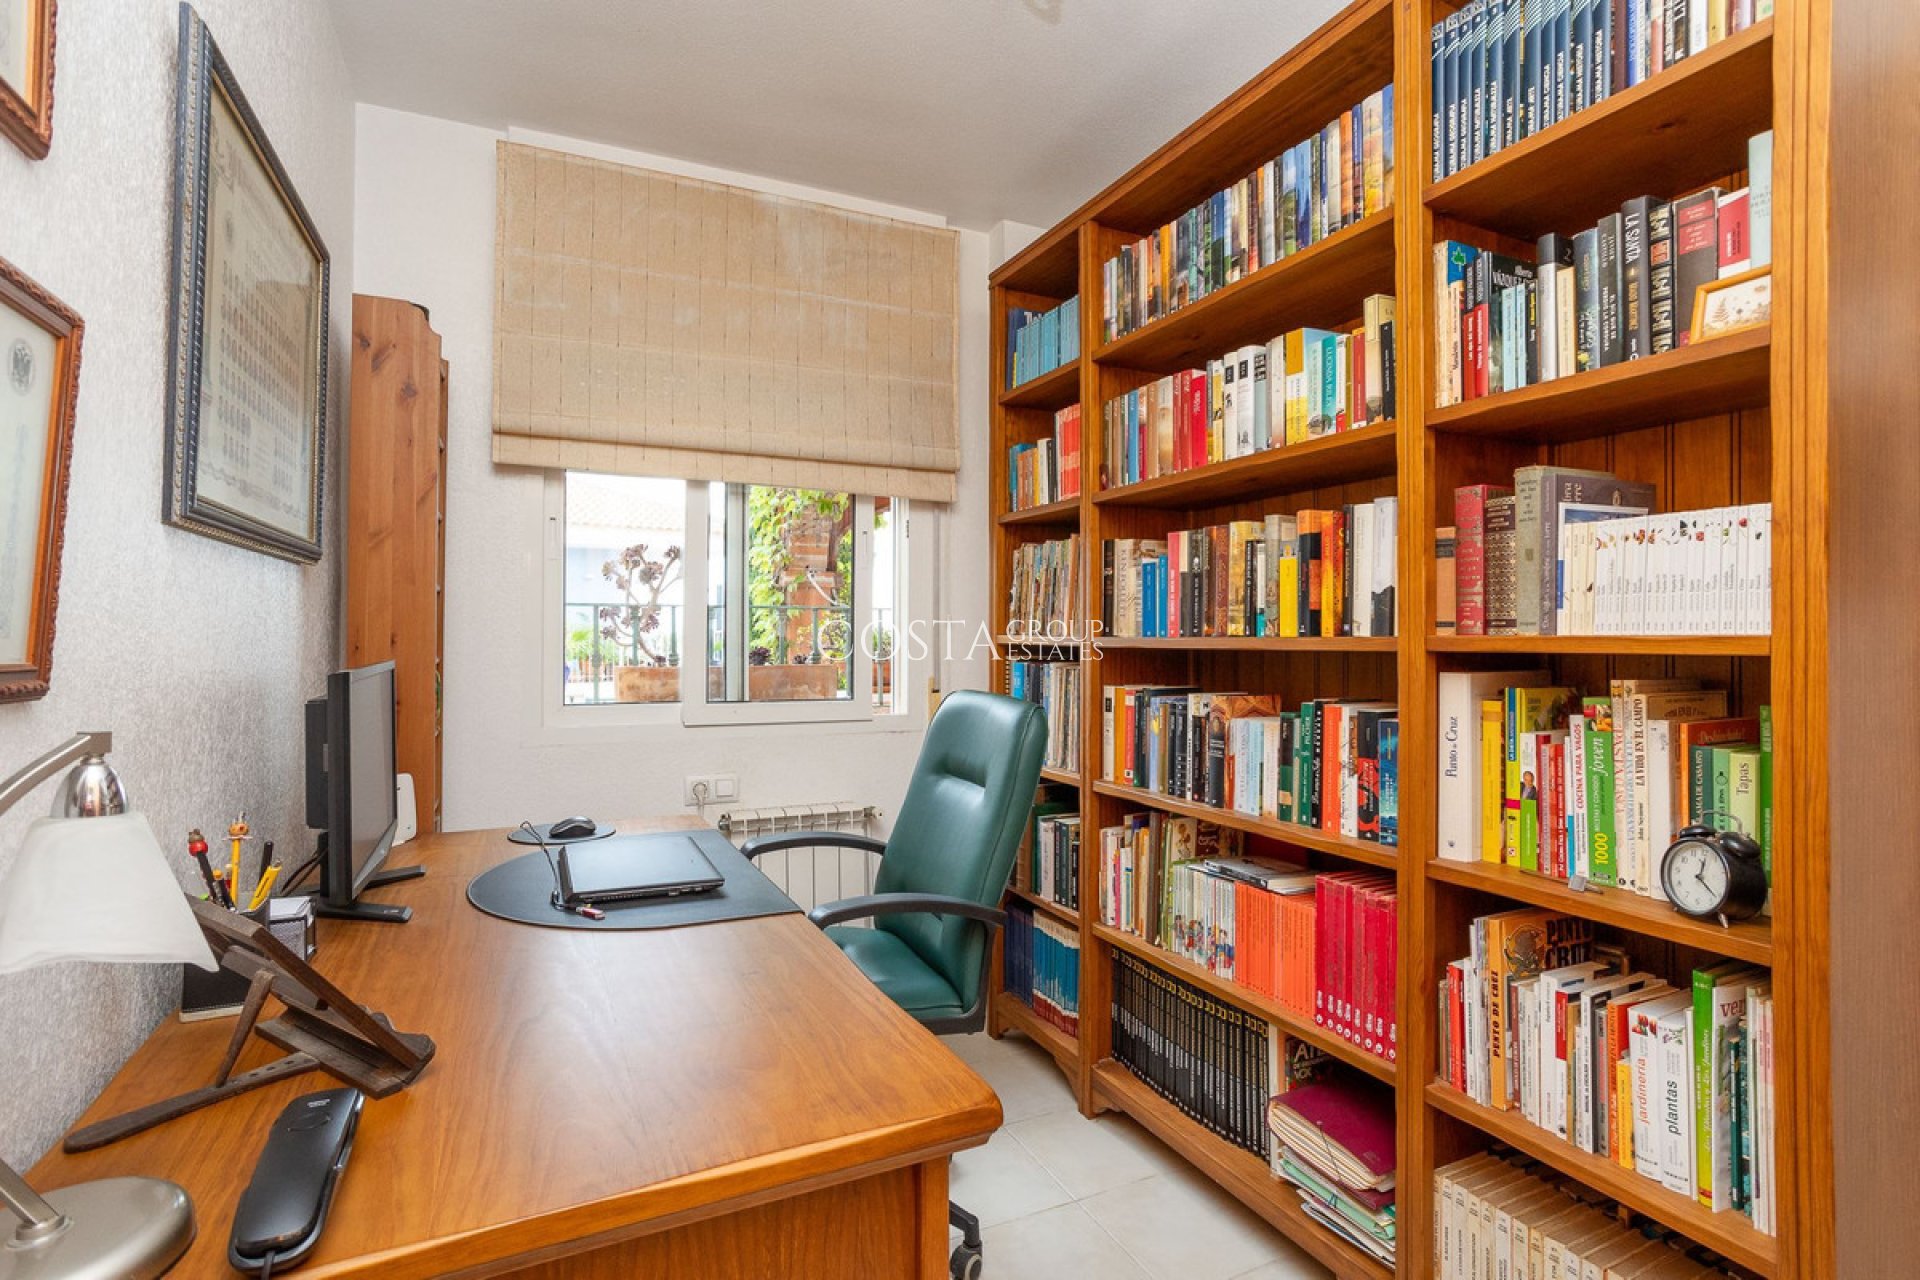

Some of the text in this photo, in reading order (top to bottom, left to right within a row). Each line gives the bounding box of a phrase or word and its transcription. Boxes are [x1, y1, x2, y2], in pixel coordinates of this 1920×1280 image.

[1626, 212, 1641, 264] LA SANTA
[1445, 716, 1458, 740] Cruz
[1633, 699, 1645, 786] LA VIDA EN EL CAMPO
[1445, 750, 1458, 778] Punto
[1589, 737, 1607, 776] joven
[1576, 778, 1584, 809] COCINA
[1736, 762, 1752, 795] Tapas
[1594, 833, 1608, 865] 1000
[1492, 1002, 1499, 1016] DE
[1667, 1080, 1682, 1136] plantas
